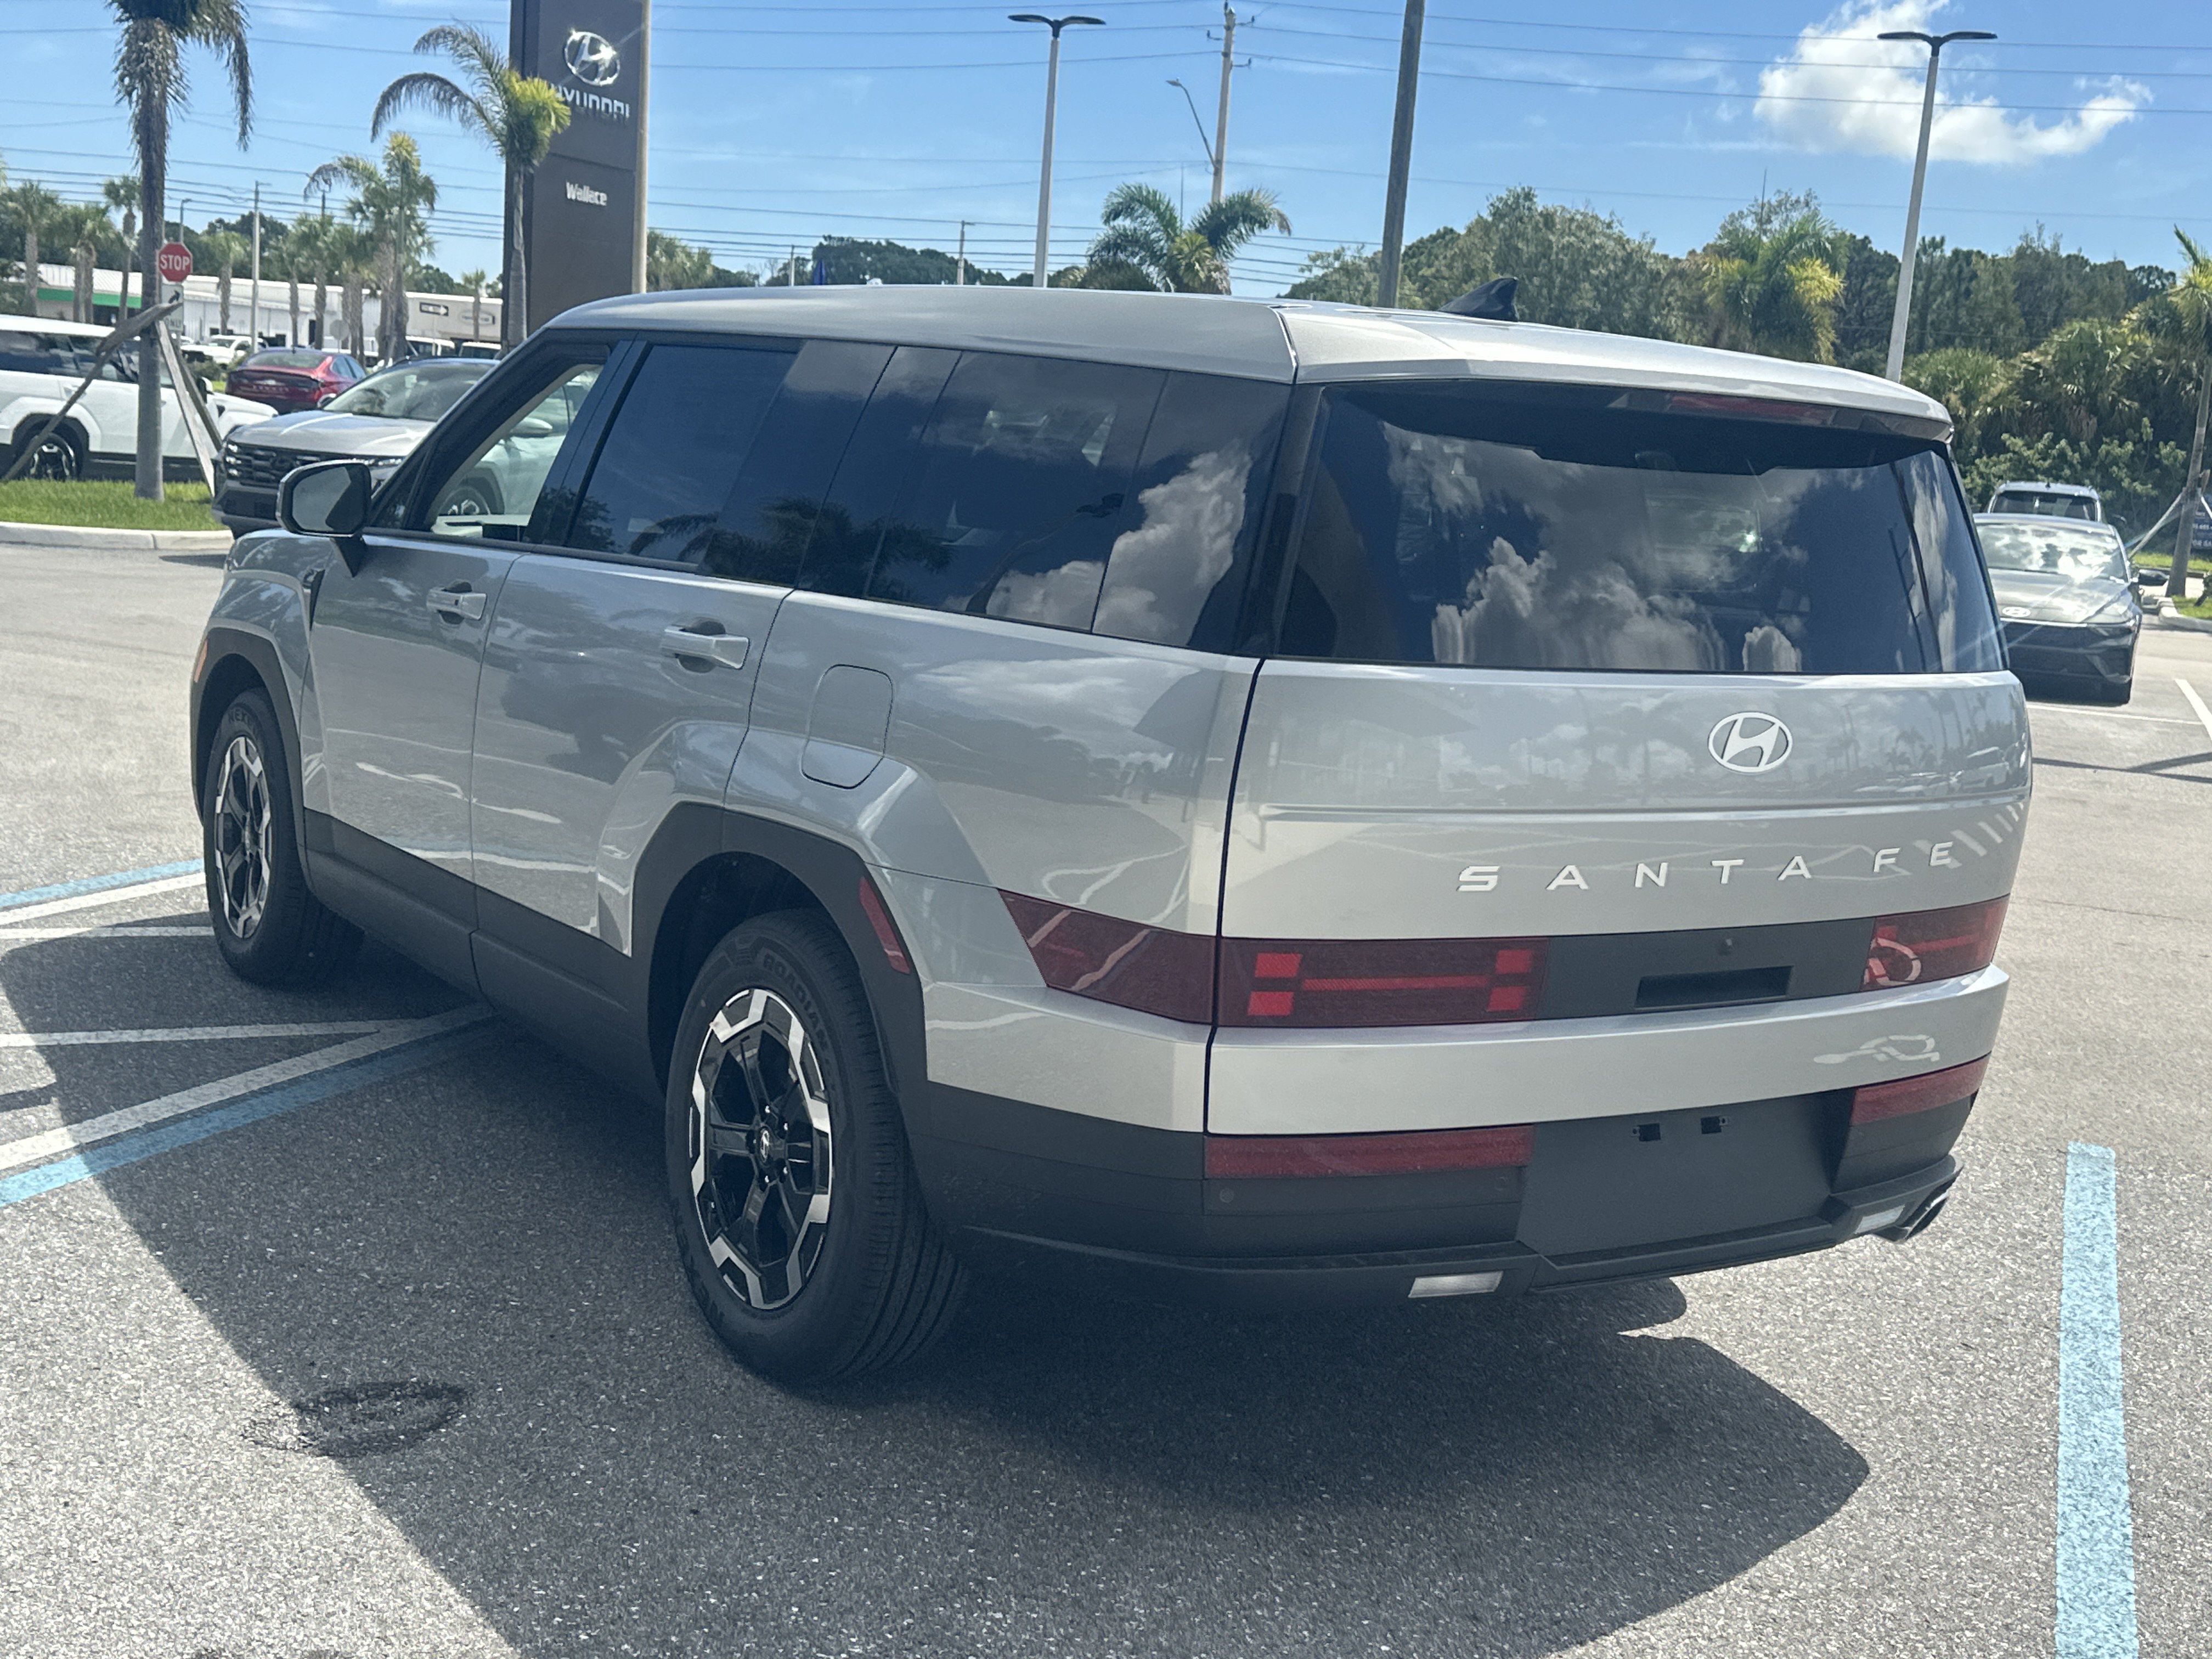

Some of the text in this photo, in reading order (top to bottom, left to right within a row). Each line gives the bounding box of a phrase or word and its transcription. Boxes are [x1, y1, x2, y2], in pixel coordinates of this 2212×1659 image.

[566, 182, 607, 206] Wallace
[160, 254, 190, 271] STOP
[1455, 841, 1954, 891] SANTA FE
